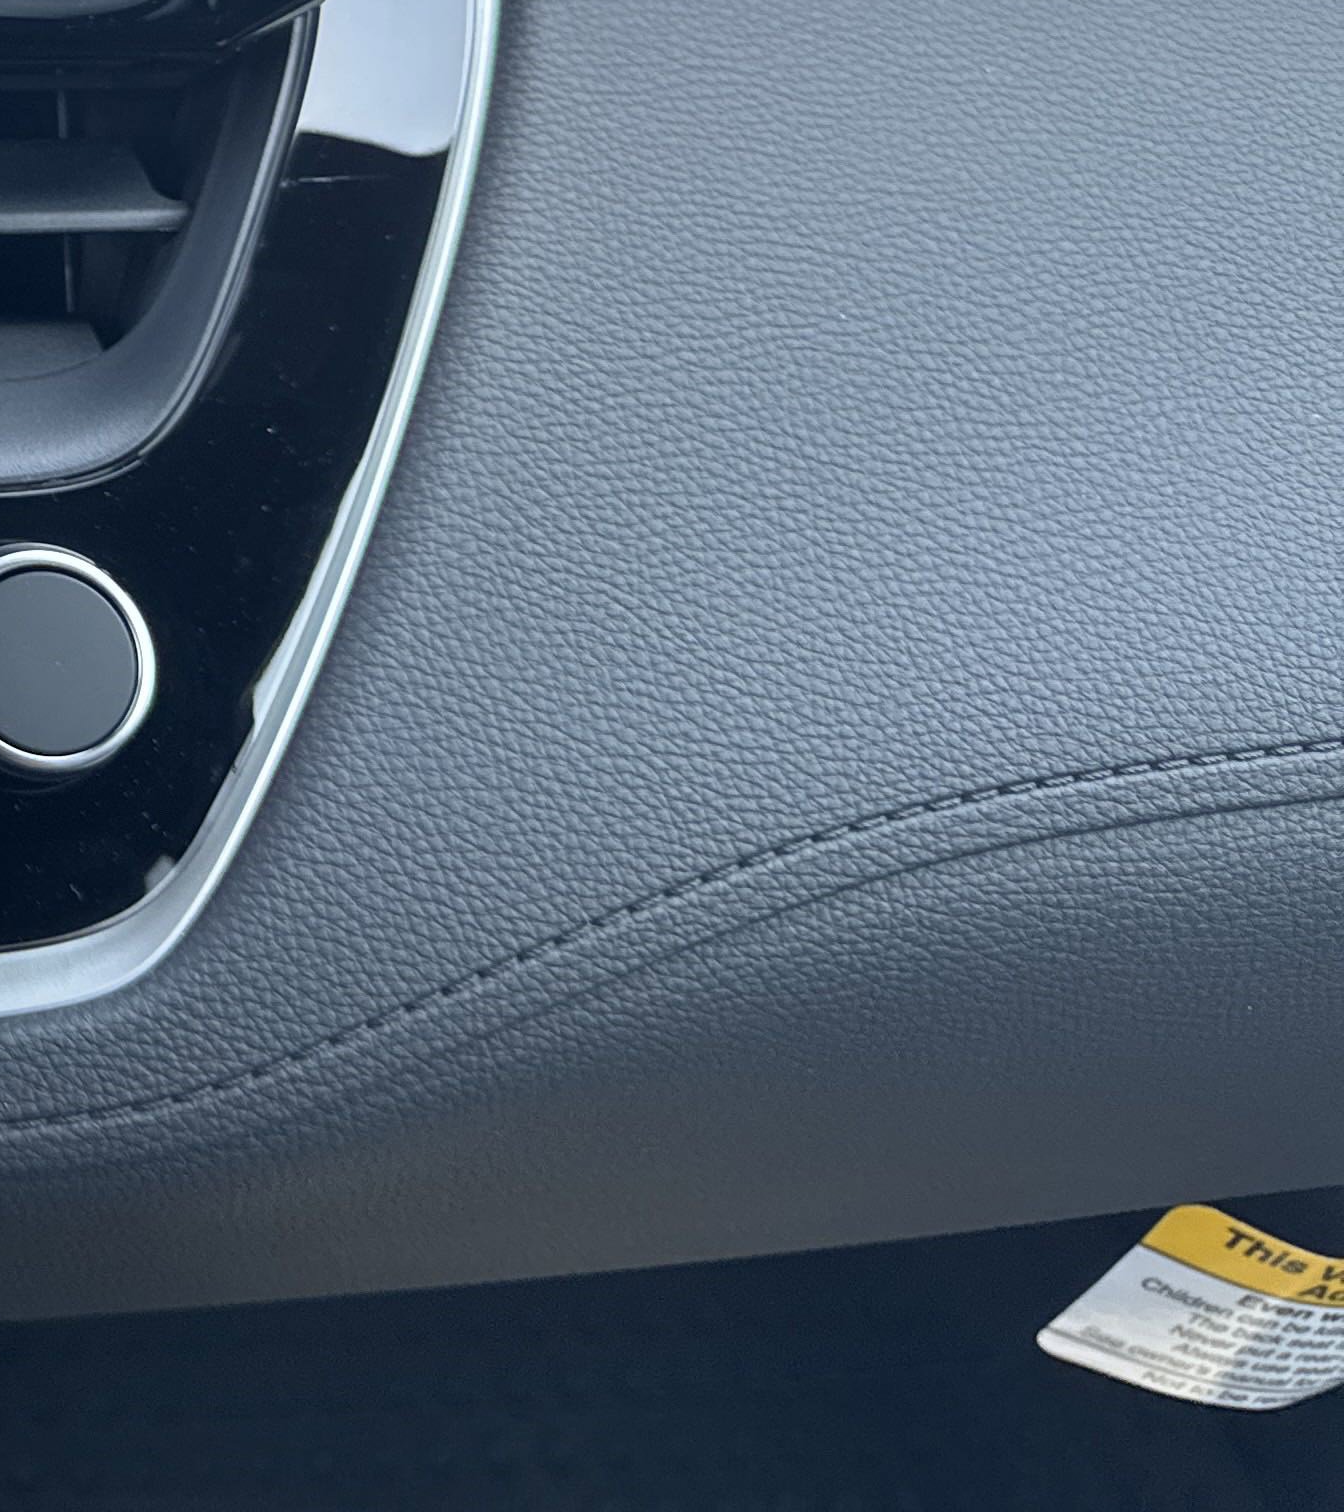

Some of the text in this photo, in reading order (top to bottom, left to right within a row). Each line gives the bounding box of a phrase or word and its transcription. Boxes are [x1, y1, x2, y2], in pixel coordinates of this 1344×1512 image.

[1226, 1226, 1308, 1274] This
[1140, 1276, 1234, 1318] Children
[1238, 1293, 1313, 1319] Even
